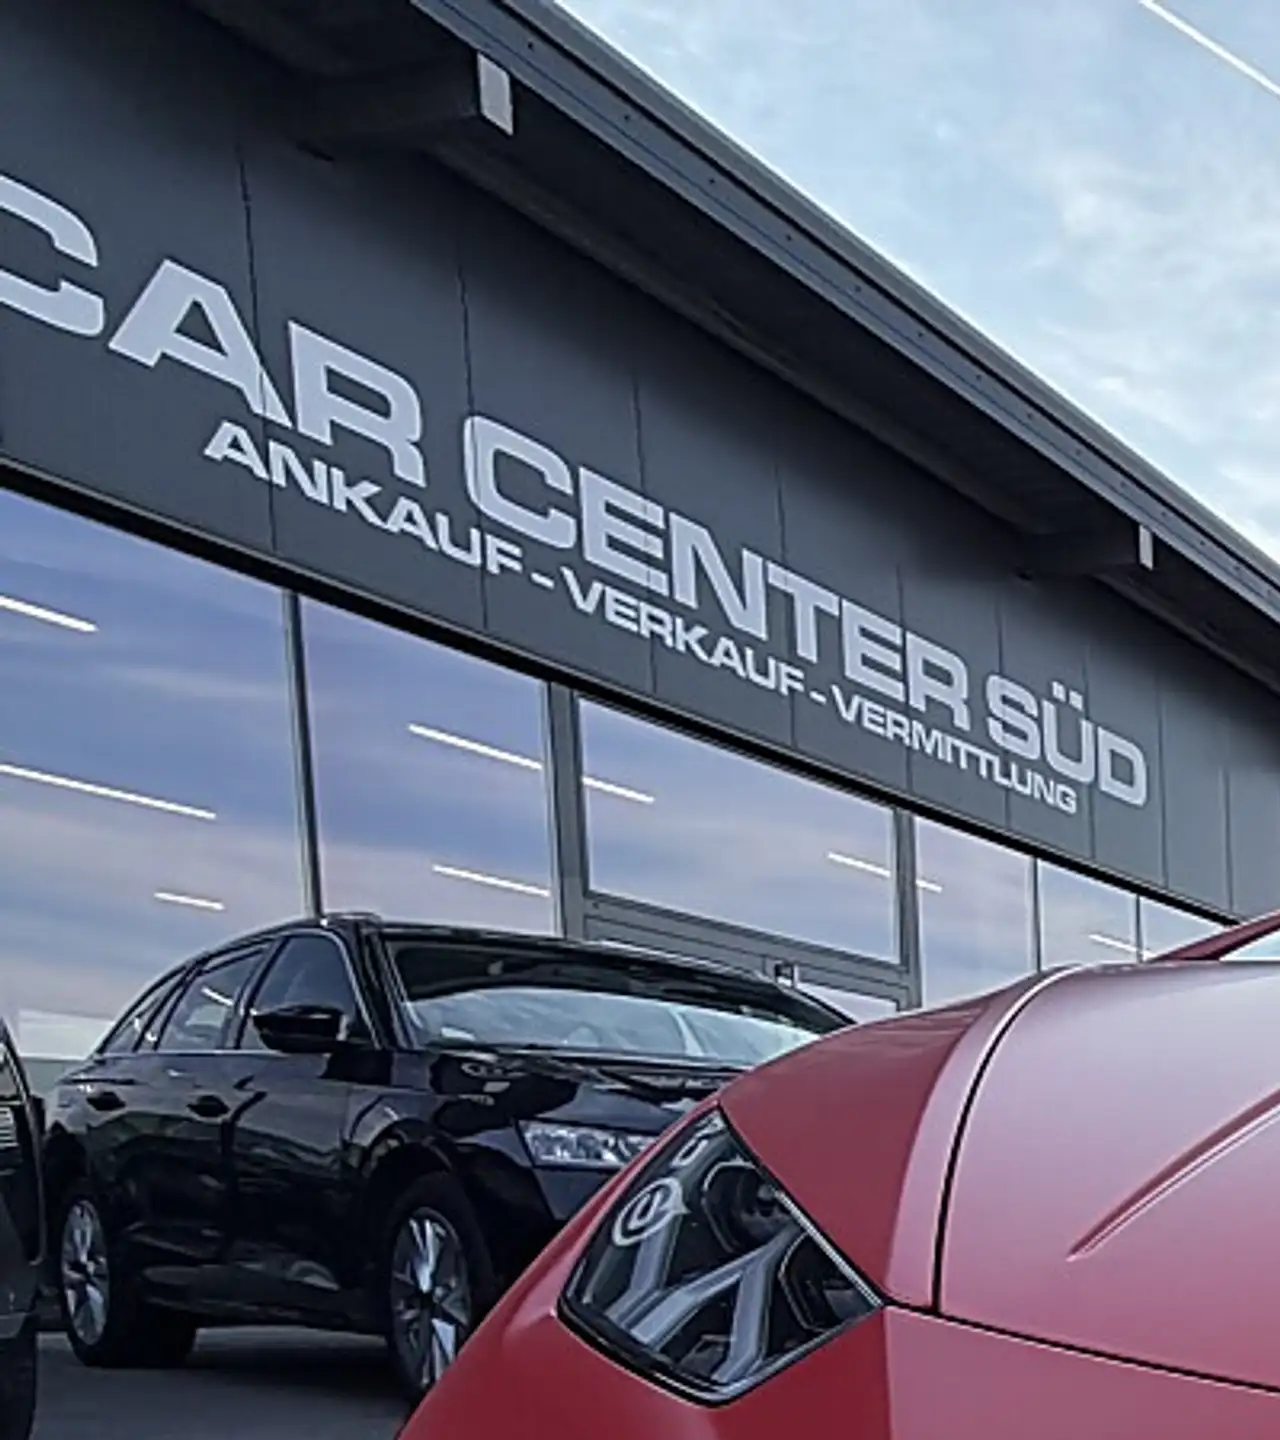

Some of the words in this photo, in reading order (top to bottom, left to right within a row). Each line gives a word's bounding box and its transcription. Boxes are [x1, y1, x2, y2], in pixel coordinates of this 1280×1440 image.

[0, 173, 427, 488] CAR
[463, 415, 972, 733] CENTER
[985, 673, 1149, 808] SÜD
[203, 420, 523, 577] ANKAUF
[560, 565, 806, 698] VERKAUF
[830, 683, 1079, 816] VERMITTLUNG
